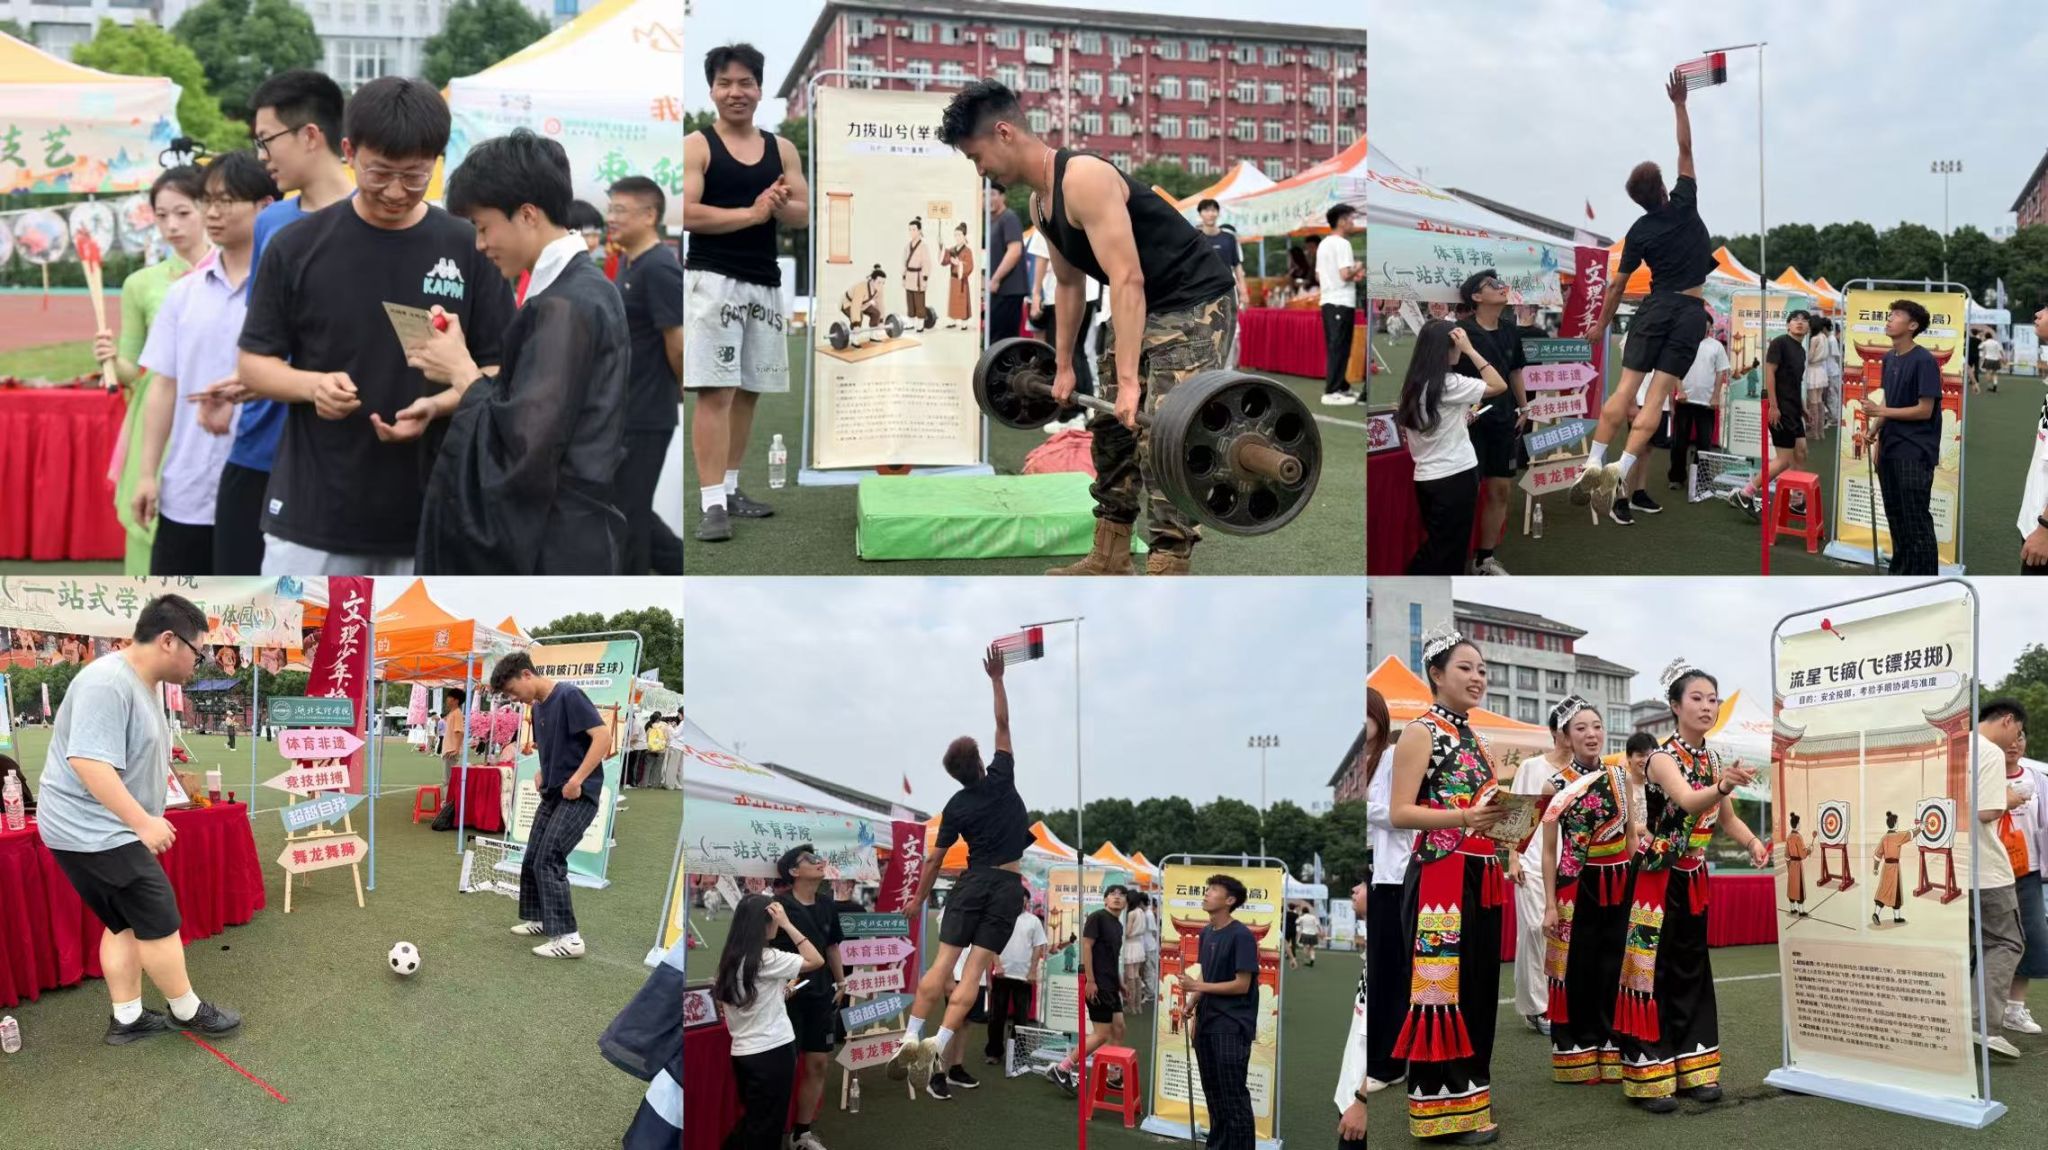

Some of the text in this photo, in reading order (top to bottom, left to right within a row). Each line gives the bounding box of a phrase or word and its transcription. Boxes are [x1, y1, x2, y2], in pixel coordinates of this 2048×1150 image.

[1433, 245, 1496, 268] 体育学院
[1574, 259, 1605, 338] 文理少年
[1528, 369, 1582, 385] 体育非遗
[1531, 422, 1585, 451] 超越自我
[1789, 643, 1953, 690] 流星飞镝(飞镖投掷)
[286, 736, 347, 751] 体育非遗
[285, 772, 344, 789] 竞技拼搏
[288, 797, 347, 826] 超越自我
[751, 819, 812, 842] 体育学院
[292, 841, 356, 865] 舞龙舞狮
[891, 834, 922, 913] 文理少年
[846, 943, 900, 958] 体育非遗
[848, 974, 899, 991] 竞技拼搏
[848, 997, 902, 1026] 超越自我
